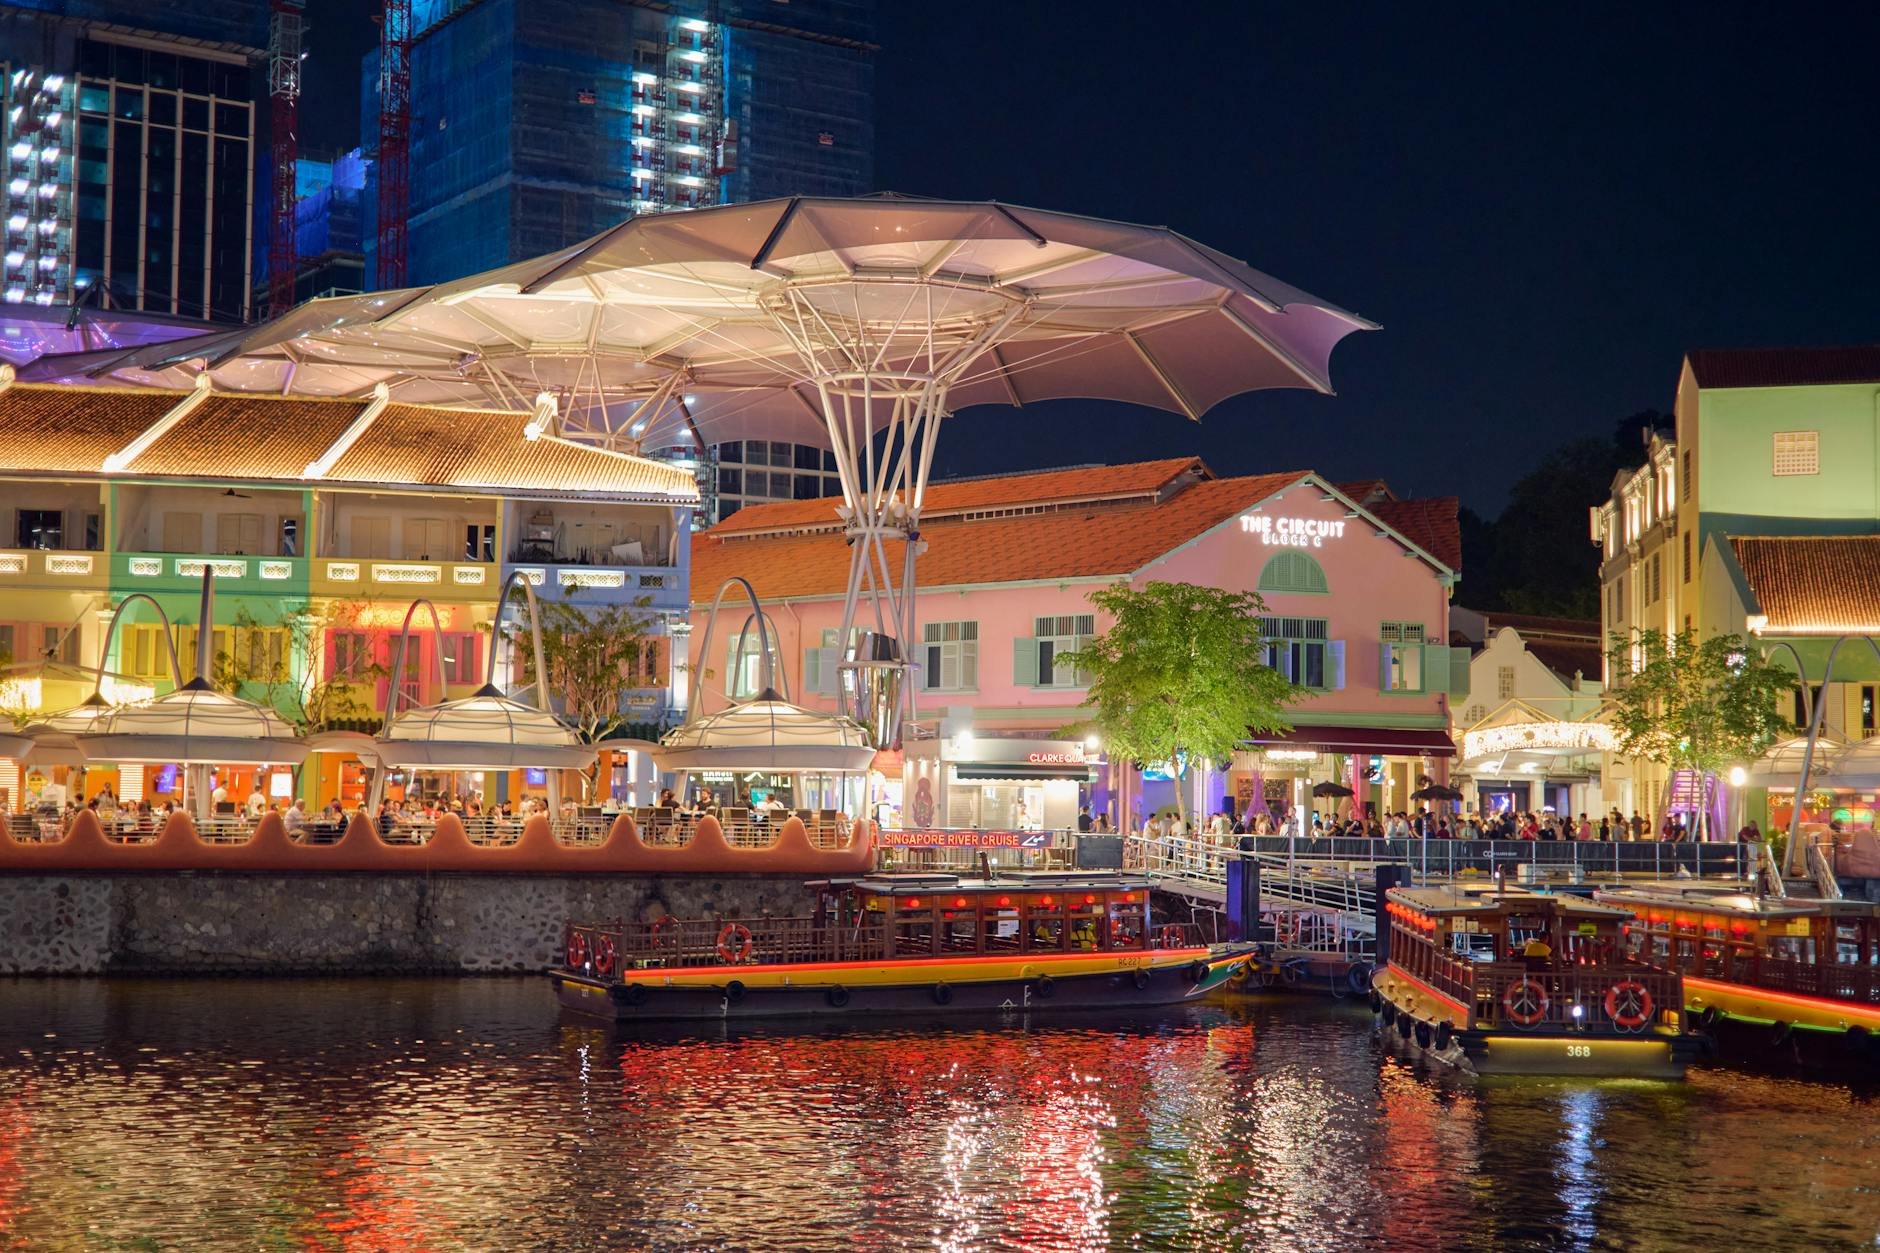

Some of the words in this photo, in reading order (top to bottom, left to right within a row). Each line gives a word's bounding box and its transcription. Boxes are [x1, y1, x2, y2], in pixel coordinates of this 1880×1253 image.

[1240, 515, 1271, 533] THE
[1276, 517, 1345, 537] CIRCUIT
[1029, 753, 1064, 763] CLARKE
[884, 833, 945, 845] SINGAPORE
[947, 834, 979, 846] RIVER
[981, 834, 1019, 846] CRUISE
[1566, 1045, 1591, 1057] 368
